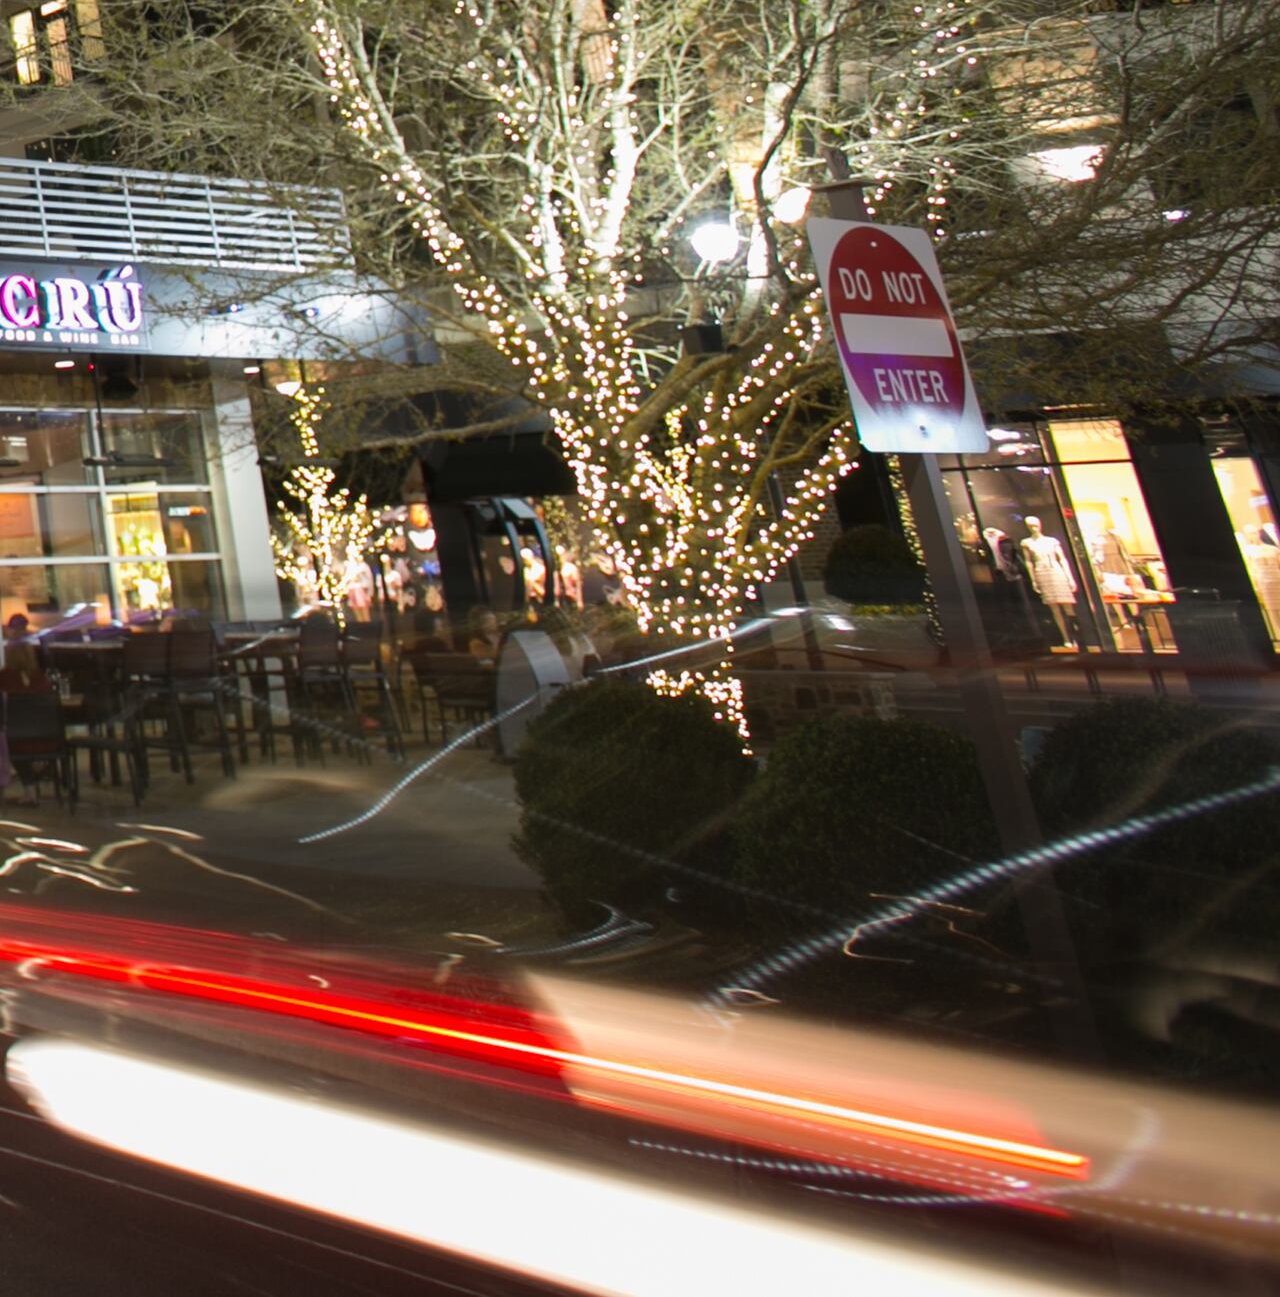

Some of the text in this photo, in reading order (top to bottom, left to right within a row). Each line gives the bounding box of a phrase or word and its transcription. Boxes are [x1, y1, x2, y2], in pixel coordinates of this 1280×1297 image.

[838, 267, 926, 305] DO NOT
[873, 367, 949, 404] ENTER
